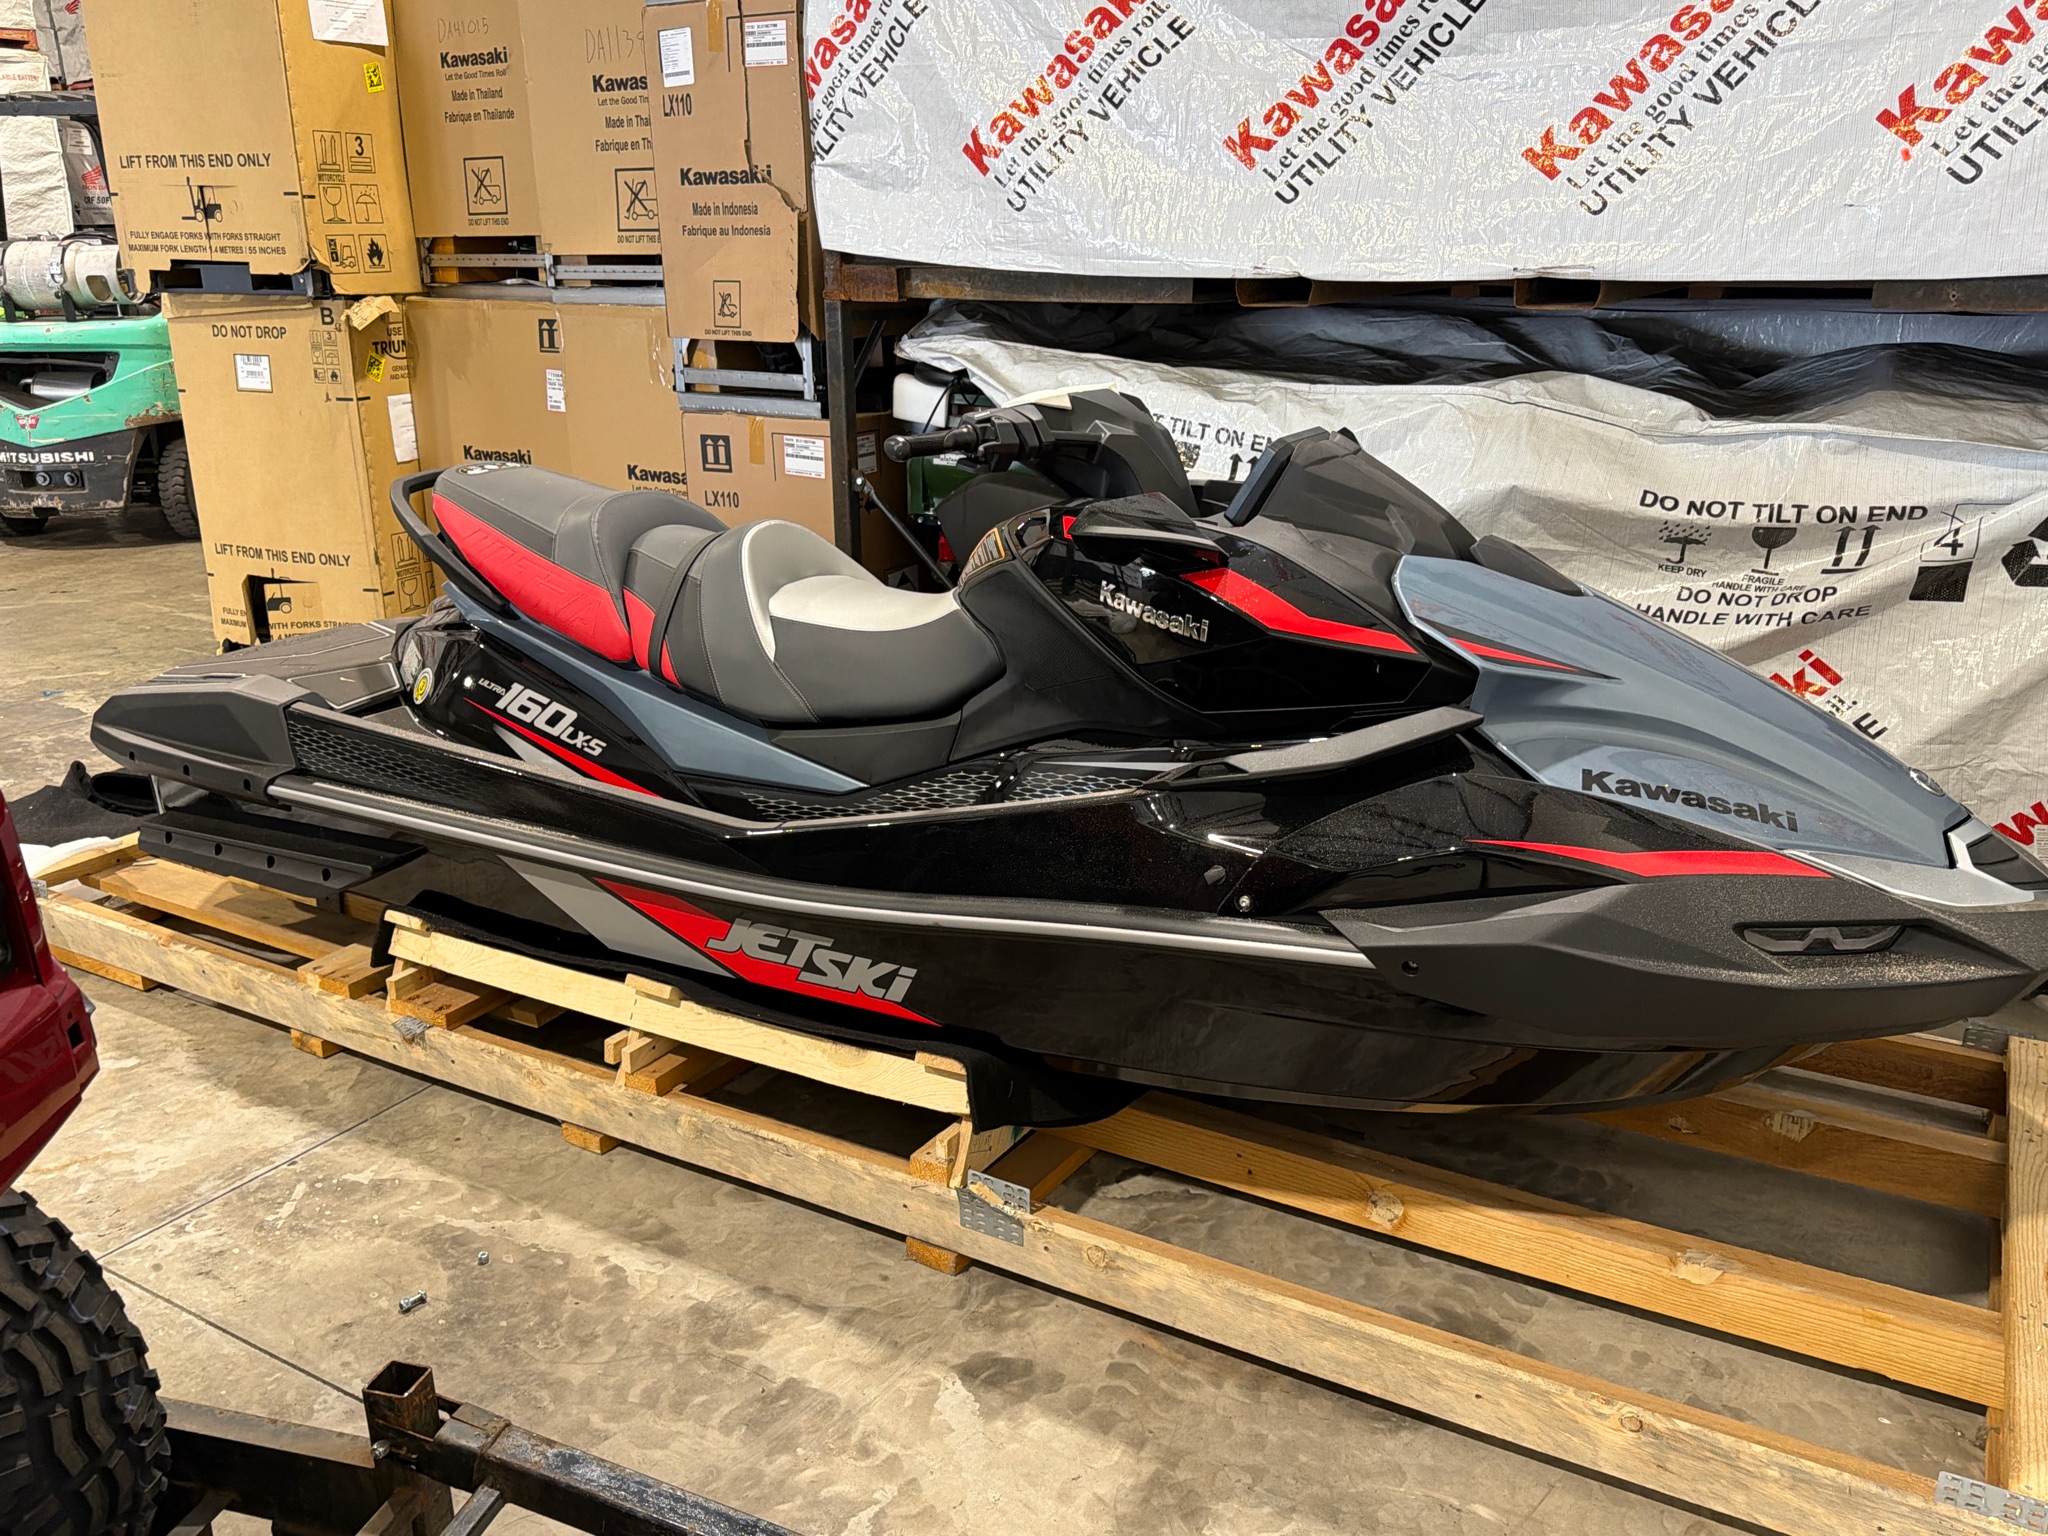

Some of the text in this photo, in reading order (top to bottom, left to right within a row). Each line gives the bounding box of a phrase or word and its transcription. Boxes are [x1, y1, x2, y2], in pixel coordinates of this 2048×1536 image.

[847, 16, 883, 64] times
[848, 0, 929, 99] VEHICLE
[440, 46, 508, 69] Kawasaki
[445, 73, 453, 81] Let
[454, 72, 463, 80] the
[464, 70, 478, 80] Good
[478, 69, 495, 78] Times
[451, 86, 503, 102] Made in Thailand
[597, 97, 608, 106] Let
[609, 97, 619, 106] the
[620, 96, 637, 105] Good
[1262, 14, 1421, 183] Let the good times
[1566, 4, 1760, 191] Let the good times
[662, 93, 692, 117] LX110
[994, 155, 1022, 189] Let
[1020, 127, 1050, 157] the
[1051, 82, 1092, 132] good
[1087, 36, 1133, 85] times
[1006, 14, 1196, 213] UTILITY VEHICLE
[473, 112, 482, 121] en
[605, 115, 624, 129] Made
[626, 115, 634, 127] in
[1930, 74, 2027, 158] Let the
[354, 136, 364, 156] 3
[595, 138, 628, 154] Fabrique
[631, 140, 640, 151] en
[1274, 104, 1374, 205] UTILITY
[119, 152, 271, 169] LIFT FROM THIS END ONLY
[1579, 104, 1696, 216] UTILITY
[317, 173, 346, 183] MOTORCYCLE
[680, 164, 772, 186] Kawasaki
[692, 202, 759, 216] Made in Indonesia
[468, 217, 509, 226] DO NOT LIFT THIS END
[130, 230, 149, 240] FULLY
[151, 231, 179, 240] ENGAGE
[180, 231, 203, 240] FORKS
[222, 232, 243, 241] FORKS
[244, 232, 281, 242] STRAIGHT
[617, 235, 624, 243] DO
[625, 235, 635, 243] NOT
[635, 235, 645, 243] LIFT
[645, 235, 656, 243] THIS
[682, 225, 771, 239] Fabrique au Indonesia
[128, 243, 159, 253] MAXIMUM
[160, 244, 179, 253] FORK
[180, 244, 208, 254] LENGTH
[219, 245, 243, 254] METRES
[248, 246, 257, 255] 55
[258, 246, 287, 255] INCHES
[320, 307, 334, 326] B
[211, 324, 287, 340] DO NOT DROP
[327, 331, 332, 340] 3
[387, 327, 402, 337] USE
[1170, 416, 1211, 441] TILT
[1215, 427, 1246, 449] ON
[463, 445, 532, 465] Kawasaki
[704, 490, 740, 508] LX110
[1638, 489, 1929, 524] DO NOT TILT ON END
[214, 542, 351, 567] LIFT FROM THIS END ONLY
[396, 565, 422, 577] MOTORCYCLE
[1657, 563, 1707, 578] KEEP DRY
[1741, 574, 1785, 586] FRAGILE
[1676, 586, 1838, 607] DO NOT DROP
[1712, 581, 1808, 593] HANDLE WITH CARE
[222, 606, 240, 616] FULLY
[290, 620, 322, 630] FORKS
[1100, 579, 1209, 643] Kawasaki
[1637, 604, 1873, 627] HANDLE WITH CARE
[220, 617, 247, 628] MAXIMUM
[478, 677, 507, 696] ULTRA
[495, 682, 578, 737] 160
[1581, 768, 1799, 834] Kawasaki
